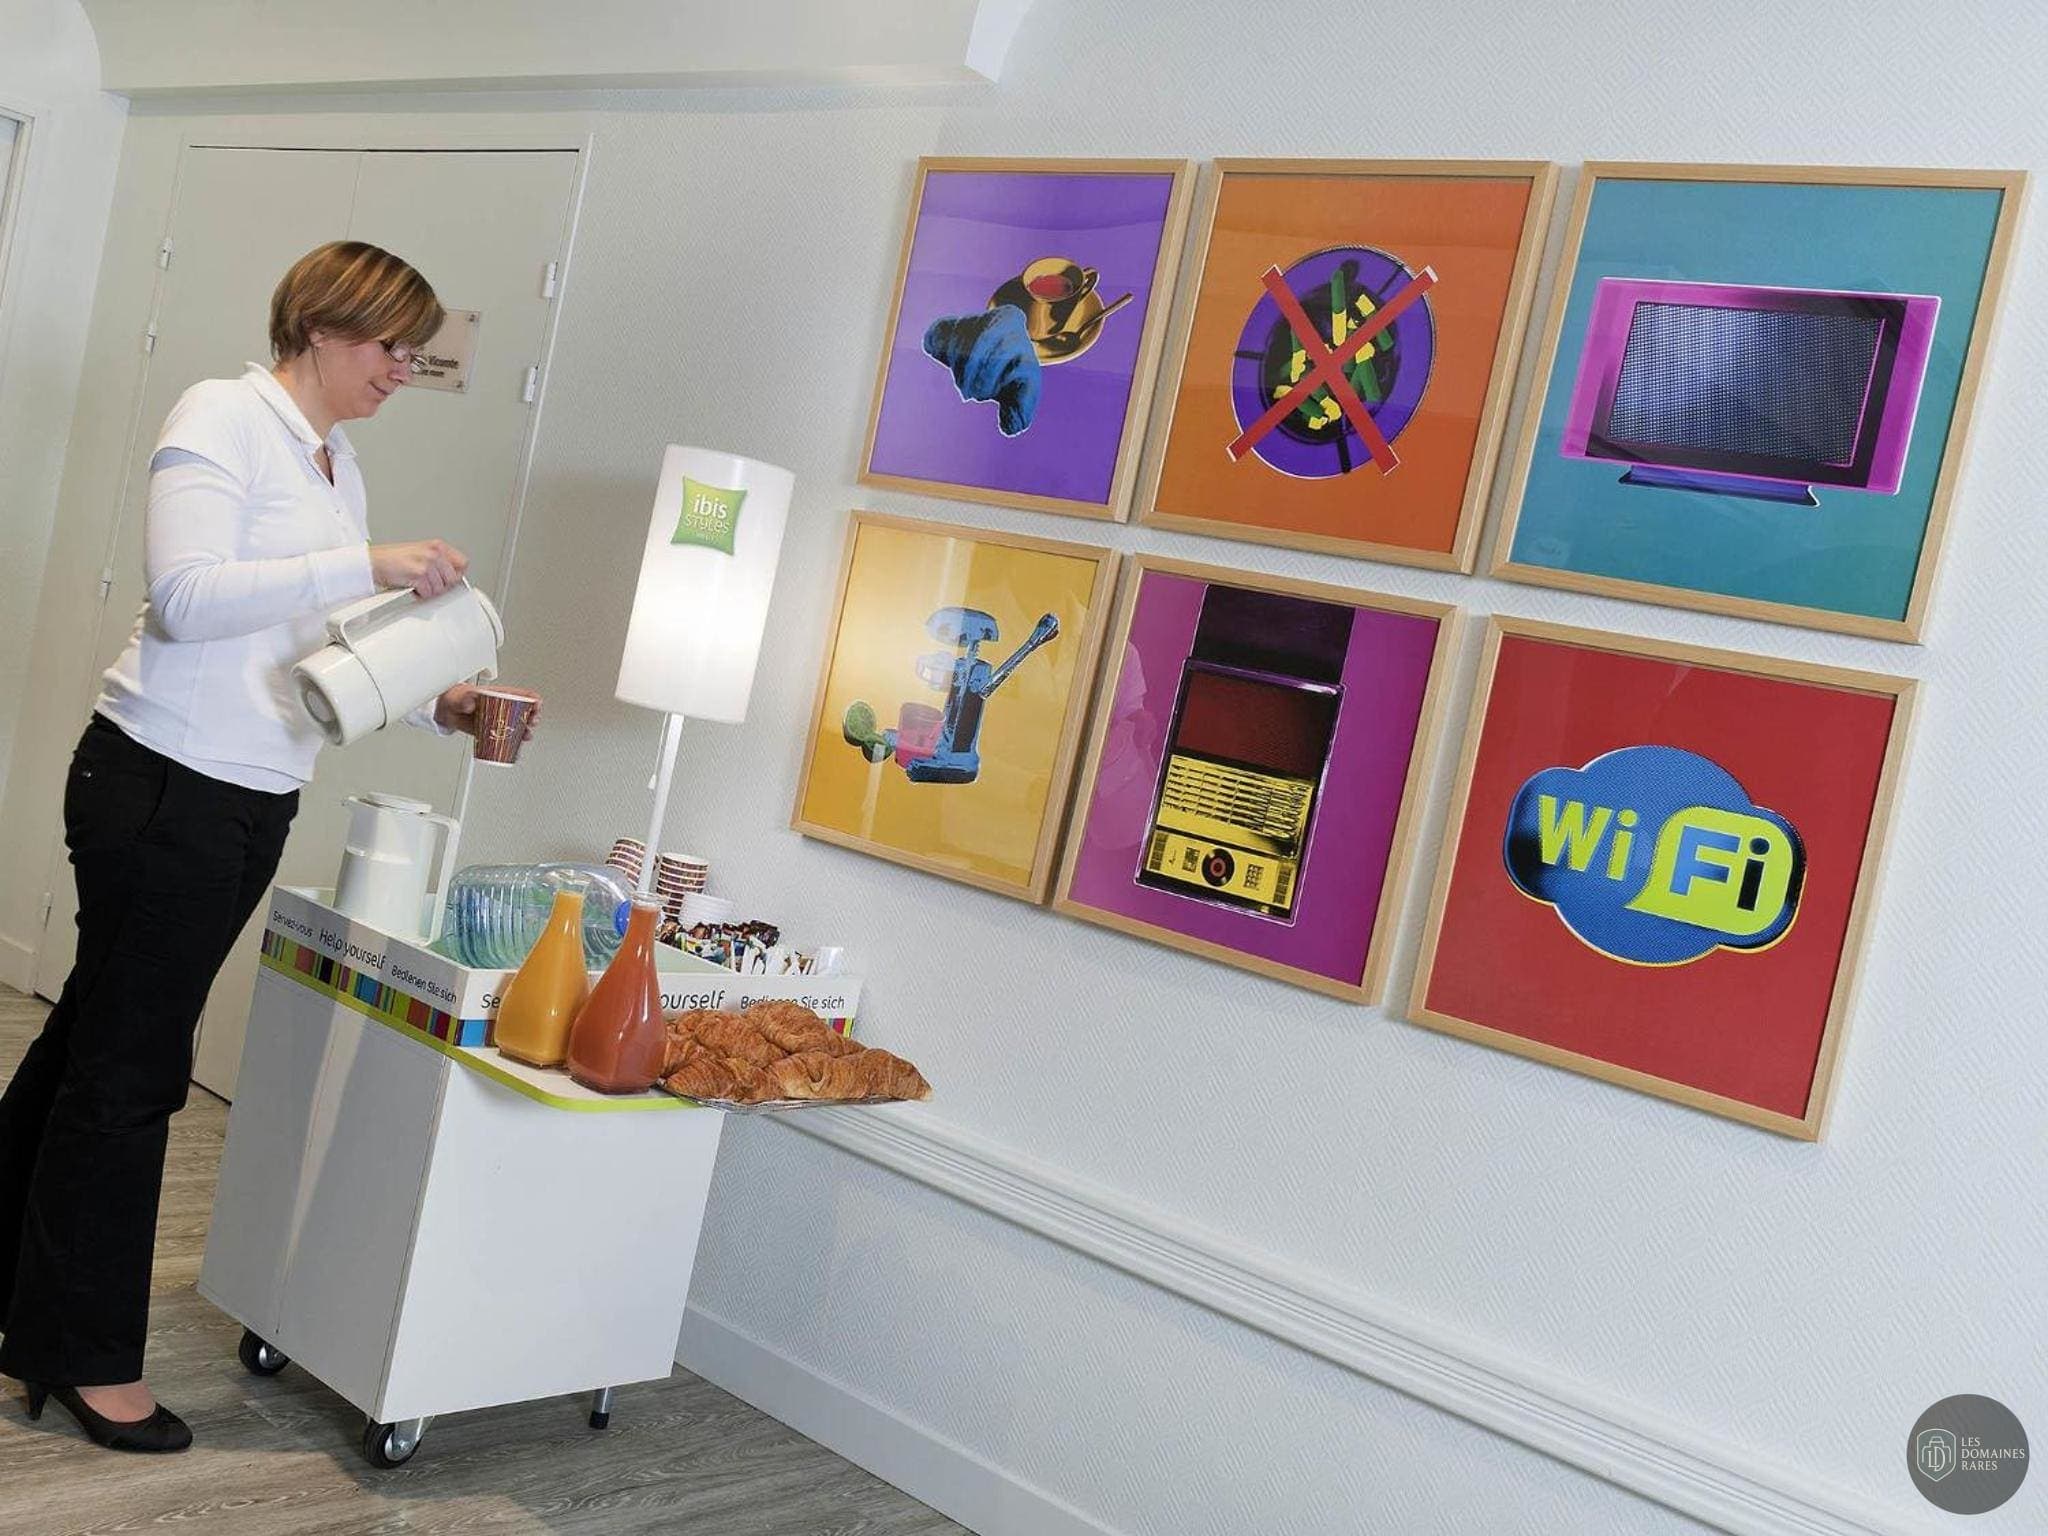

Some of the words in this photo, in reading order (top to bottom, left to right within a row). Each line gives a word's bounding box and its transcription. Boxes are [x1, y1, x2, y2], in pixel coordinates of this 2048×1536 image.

[693, 493, 728, 519] ibis
[1538, 794, 1639, 881] Wi
[1669, 825, 1770, 911] Fi
[319, 928, 343, 951] Help
[342, 941, 387, 969] yourself
[391, 964, 427, 990] Bedienen
[427, 980, 440, 996] Sie
[440, 987, 457, 1004] sich
[659, 990, 726, 1010] ourself
[800, 995, 819, 1009] Sie
[821, 995, 845, 1009] sich
